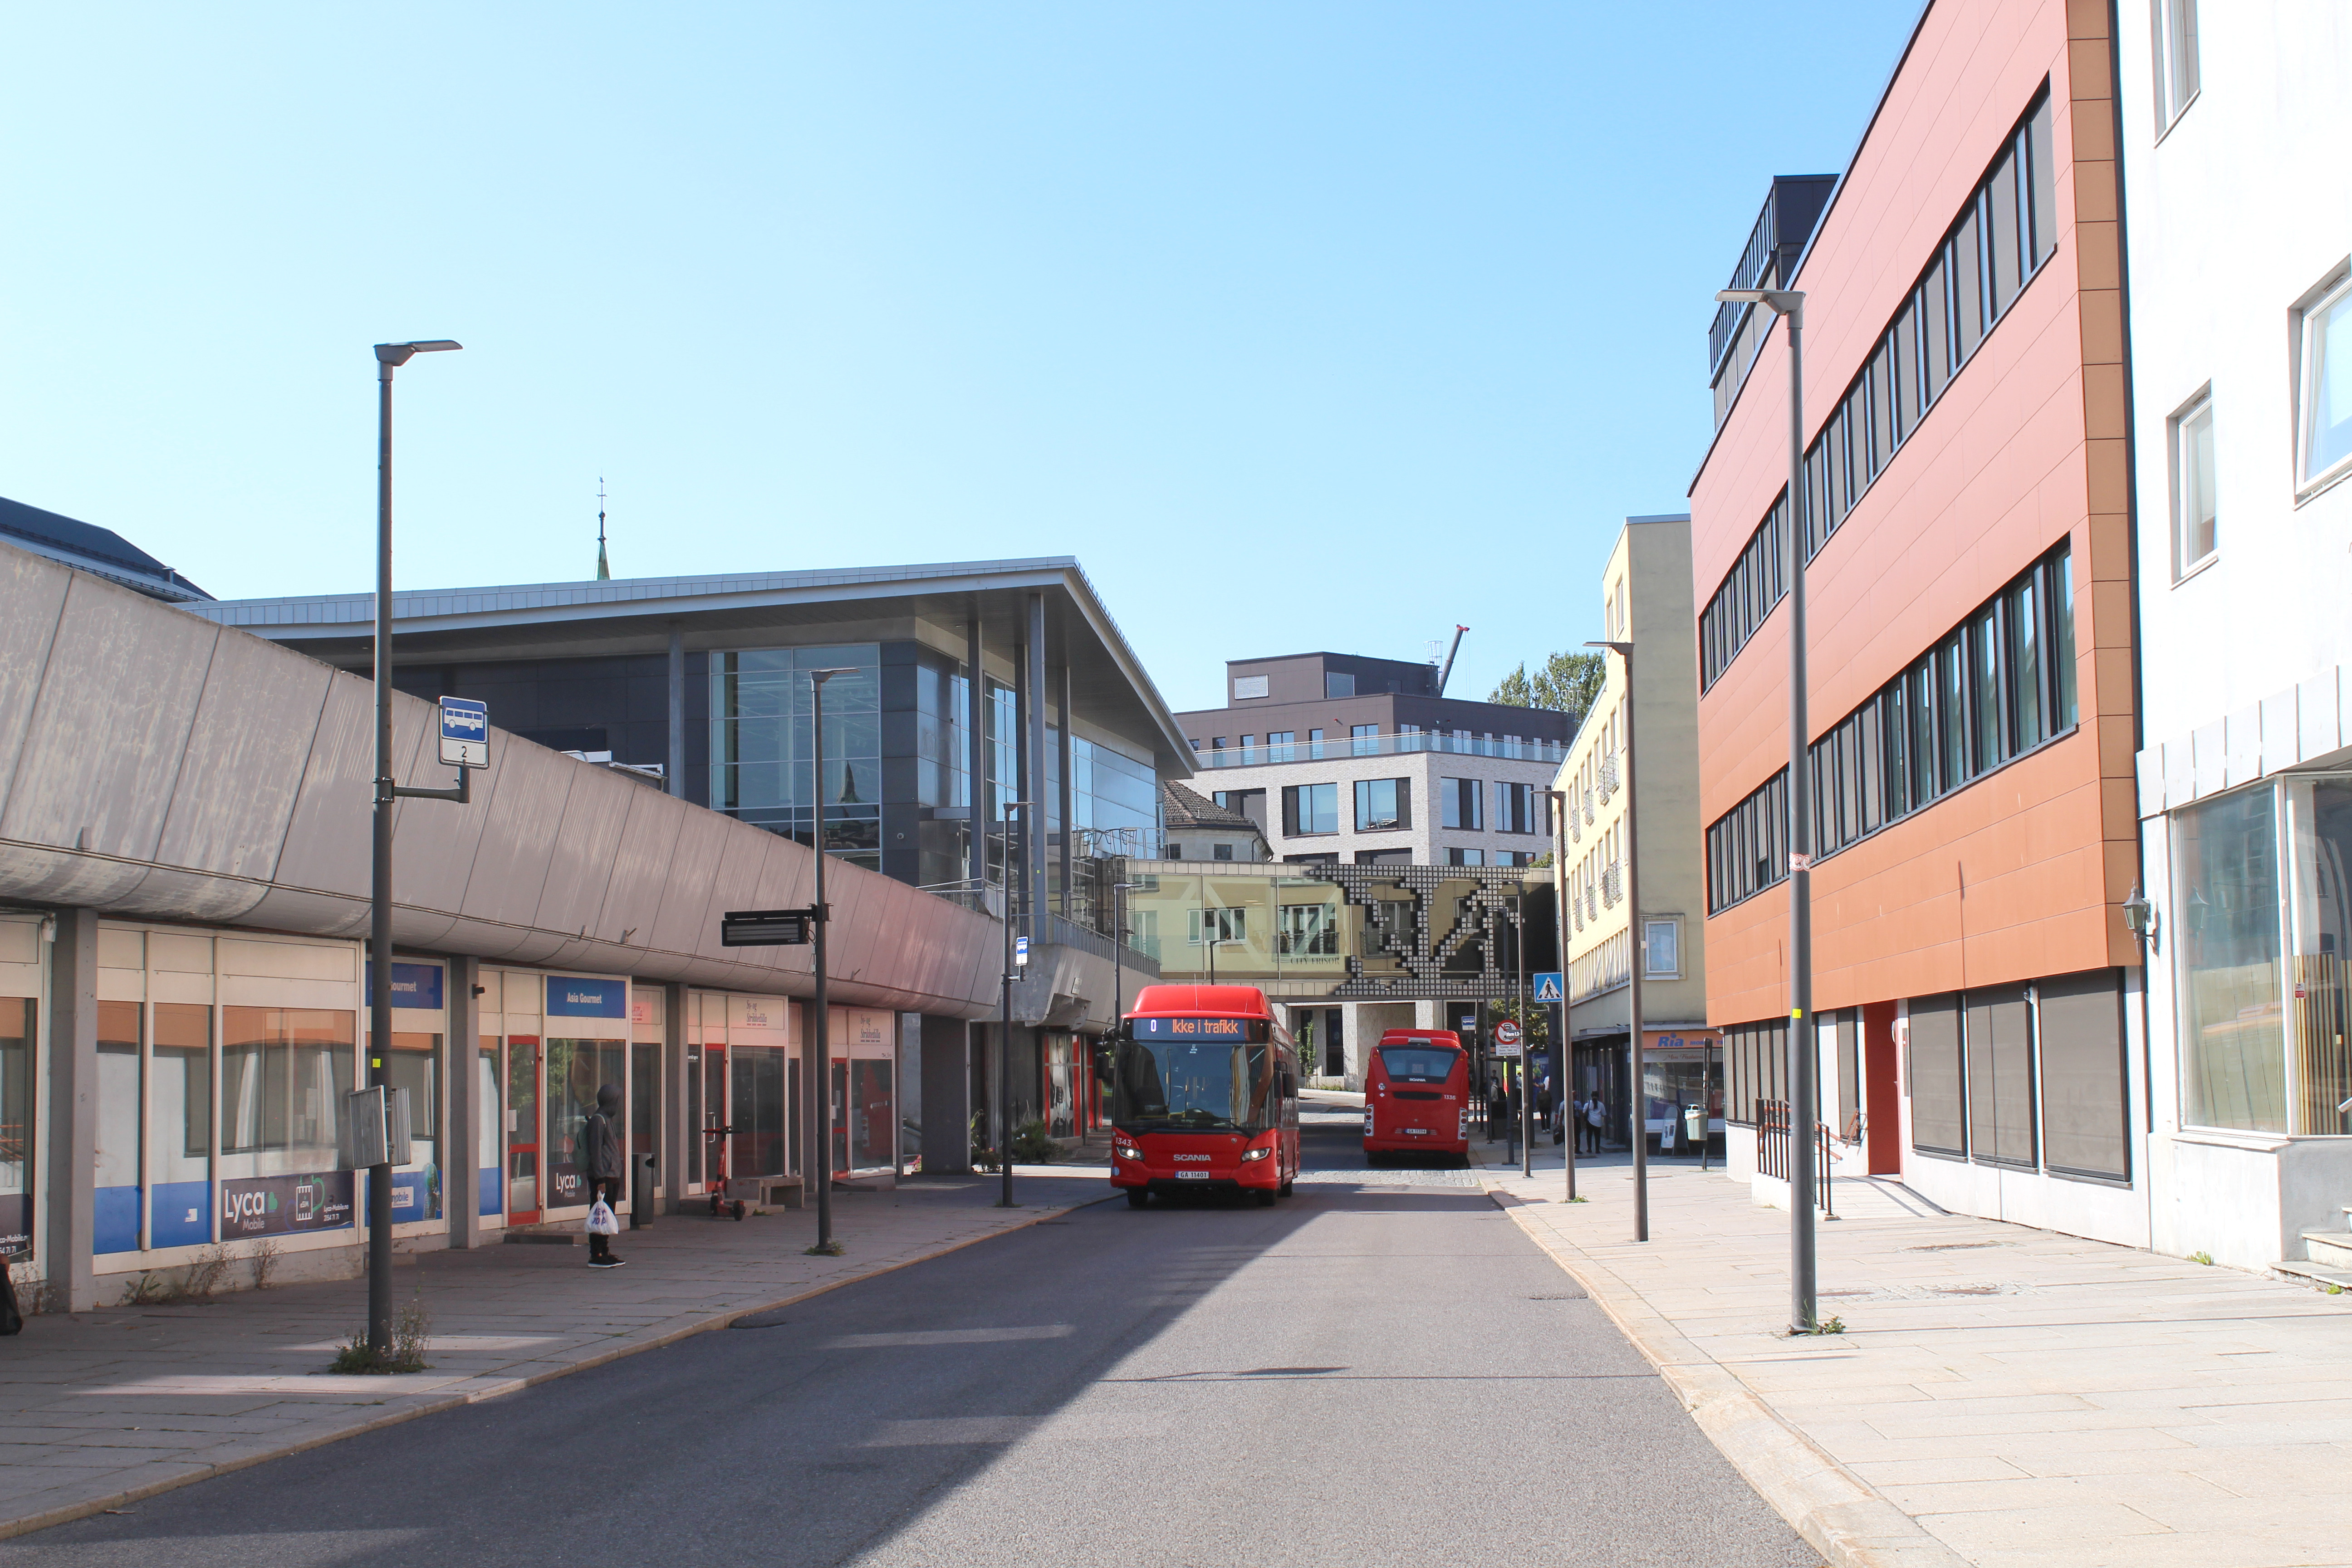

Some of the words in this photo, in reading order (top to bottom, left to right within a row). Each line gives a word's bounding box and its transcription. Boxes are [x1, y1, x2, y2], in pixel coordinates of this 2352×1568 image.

[461, 745, 467, 758] 2
[391, 981, 417, 992] ourmet
[567, 992, 579, 1003] Asia
[580, 993, 603, 1004] Gourmet
[1172, 1019, 1195, 1034] Ikke
[1198, 1019, 1201, 1034] i
[1204, 1019, 1239, 1034] trafikk
[1657, 1033, 1684, 1047] Ria
[1116, 1137, 1132, 1147] 1343
[556, 1172, 576, 1194] Lyca
[225, 1189, 265, 1224] Lyca
[323, 1204, 349, 1213] Lyca-Mobile.no
[242, 1217, 265, 1230] Mobile
